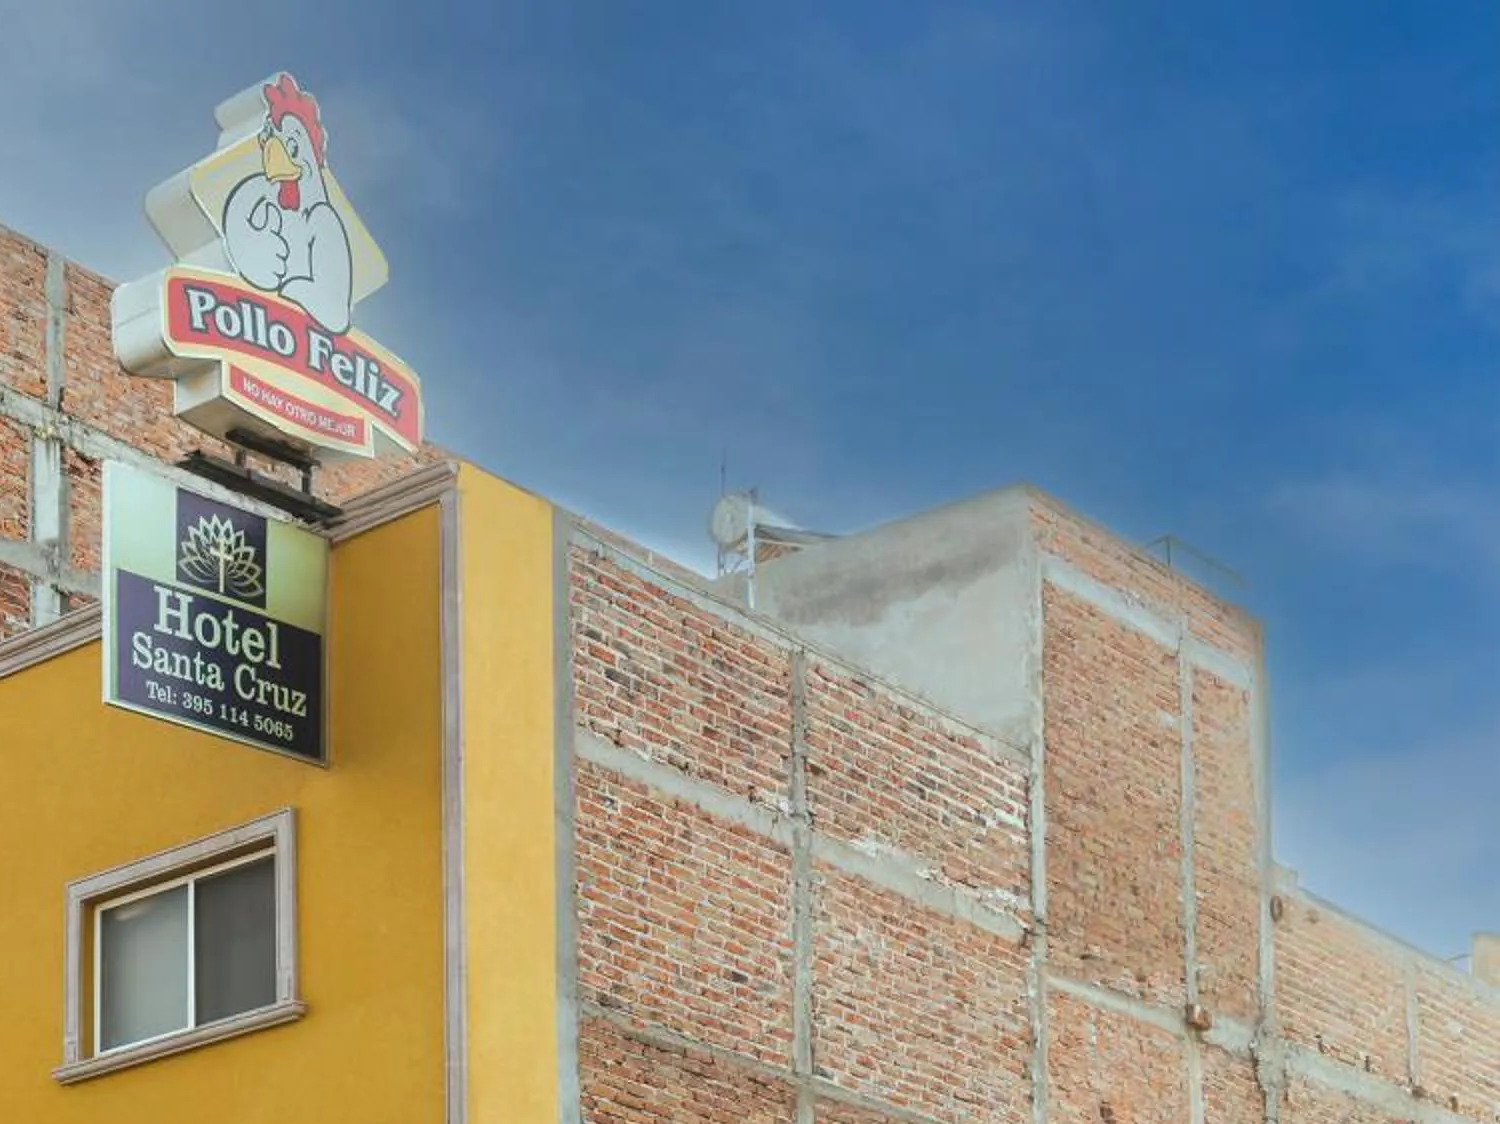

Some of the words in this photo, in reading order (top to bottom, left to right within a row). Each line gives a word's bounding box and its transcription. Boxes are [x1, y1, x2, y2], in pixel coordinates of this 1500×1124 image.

[184, 287, 296, 356] Pollo
[307, 331, 404, 418] Feliz
[243, 378, 259, 398] NO
[285, 402, 317, 425] OTRO
[319, 415, 357, 437] MEJOR
[153, 585, 281, 669] Hotel
[132, 631, 225, 692] Santa
[234, 664, 307, 717] Cruz
[146, 681, 177, 705] Tel:
[182, 692, 213, 716] 395
[219, 704, 249, 727] 114
[254, 715, 294, 740] 5065
